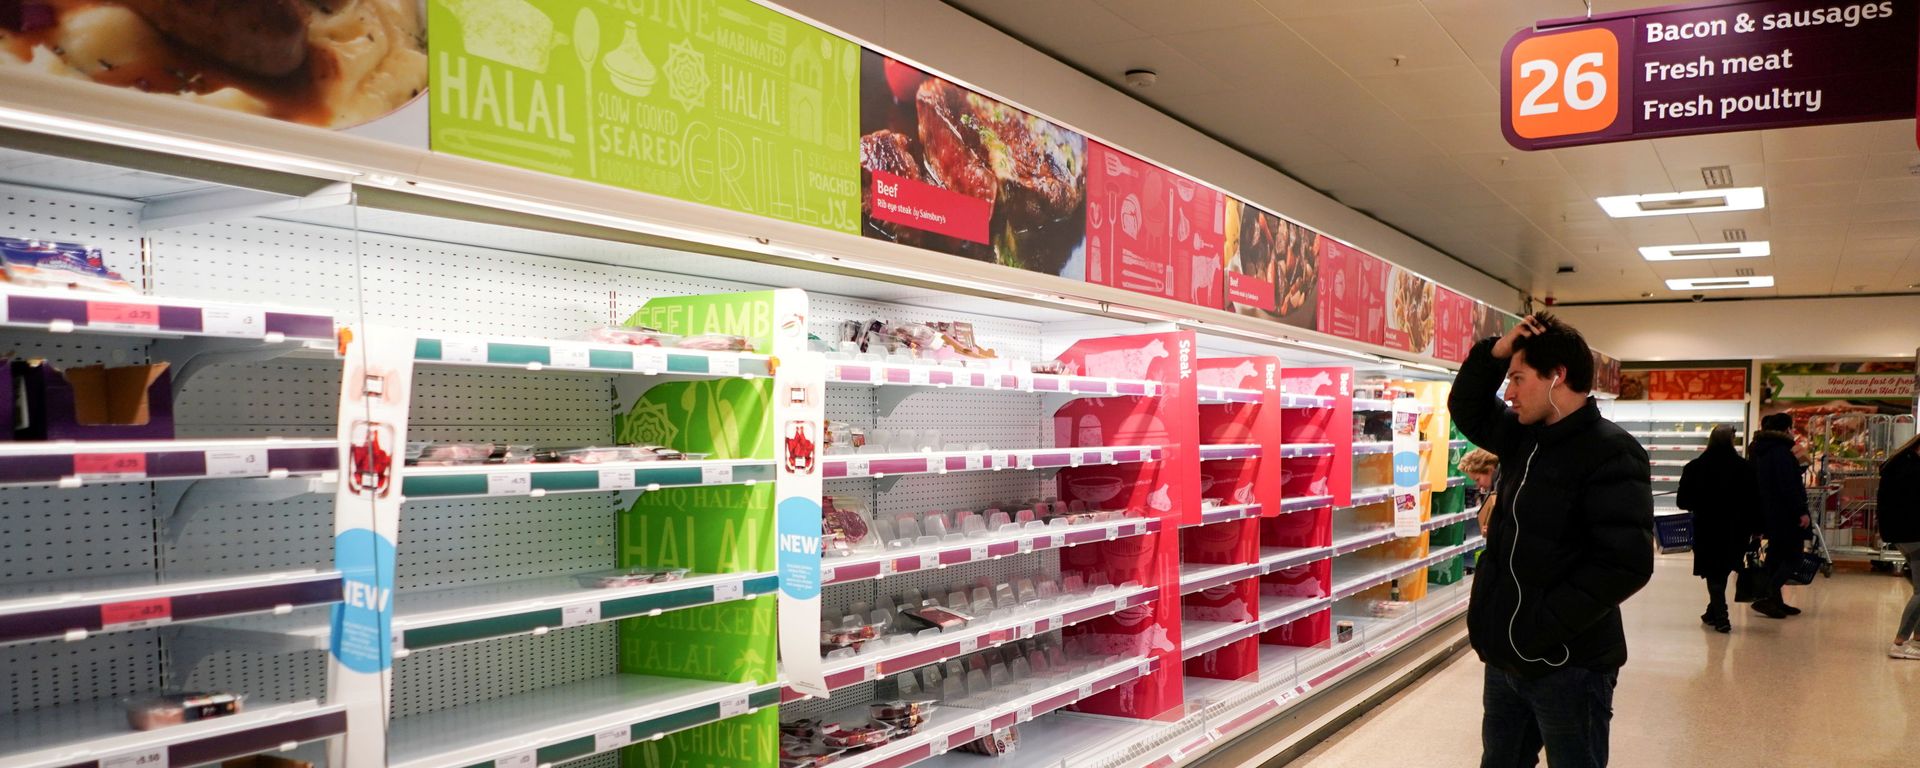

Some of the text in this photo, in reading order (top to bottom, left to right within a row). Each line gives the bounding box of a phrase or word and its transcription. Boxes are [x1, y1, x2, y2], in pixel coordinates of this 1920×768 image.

[1646, 0, 1894, 44] Bacon & sausages
[716, 26, 786, 68] MARINATED
[1644, 48, 1793, 82] Fresh meat
[439, 50, 576, 144] HALAL
[721, 63, 781, 127] HALAL
[1519, 52, 1609, 117] 26
[598, 92, 679, 137] SLOW COOKED
[1643, 88, 1823, 120] Fresh poultry
[599, 123, 682, 168] SEARED
[681, 121, 819, 226] GRILL
[808, 170, 858, 198] POACHED
[877, 180, 899, 198] Beef
[877, 199, 947, 225] Rib eye steak by Sainsbury's
[1179, 339, 1192, 380] Steak
[1265, 363, 1277, 391] Beef
[1339, 372, 1350, 397] Beef
[1815, 387, 1853, 395] available
[1864, 387, 1877, 395] the
[1879, 387, 1897, 395] Hot
[1845, 378, 1868, 387] pizza
[1868, 377, 1887, 387] fast
[1395, 465, 1418, 473] New
[693, 487, 769, 511] HALAL
[779, 533, 820, 556] NEW
[654, 605, 773, 637] CHICKEN
[624, 638, 721, 677] HALAL
[680, 721, 773, 765] CHICKEN
